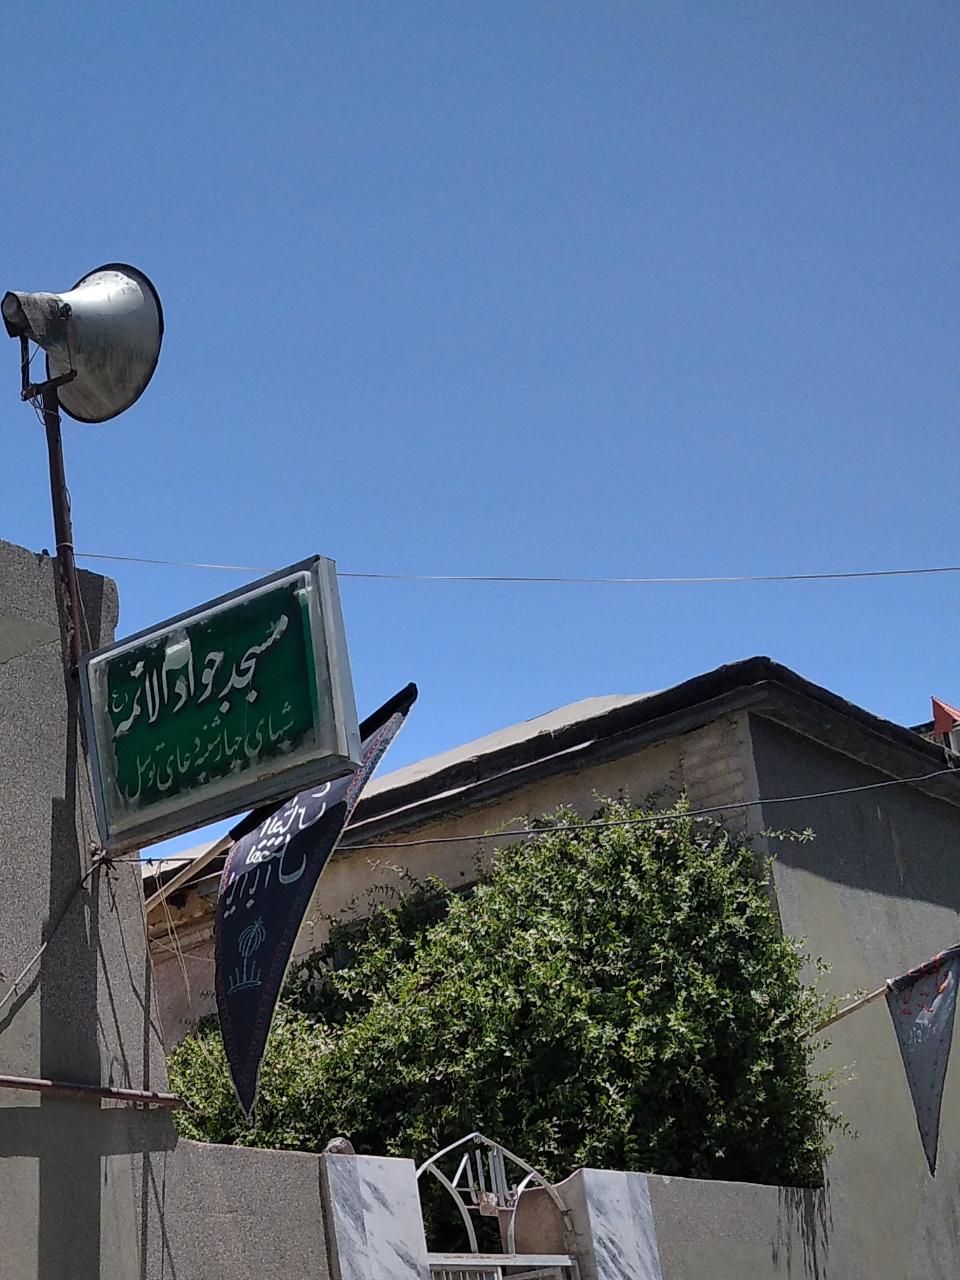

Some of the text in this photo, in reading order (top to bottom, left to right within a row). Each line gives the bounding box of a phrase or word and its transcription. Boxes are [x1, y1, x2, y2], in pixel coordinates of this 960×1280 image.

[171, 640, 231, 714] جواد
[217, 613, 289, 704] مسجد
[125, 741, 166, 801] توسل
